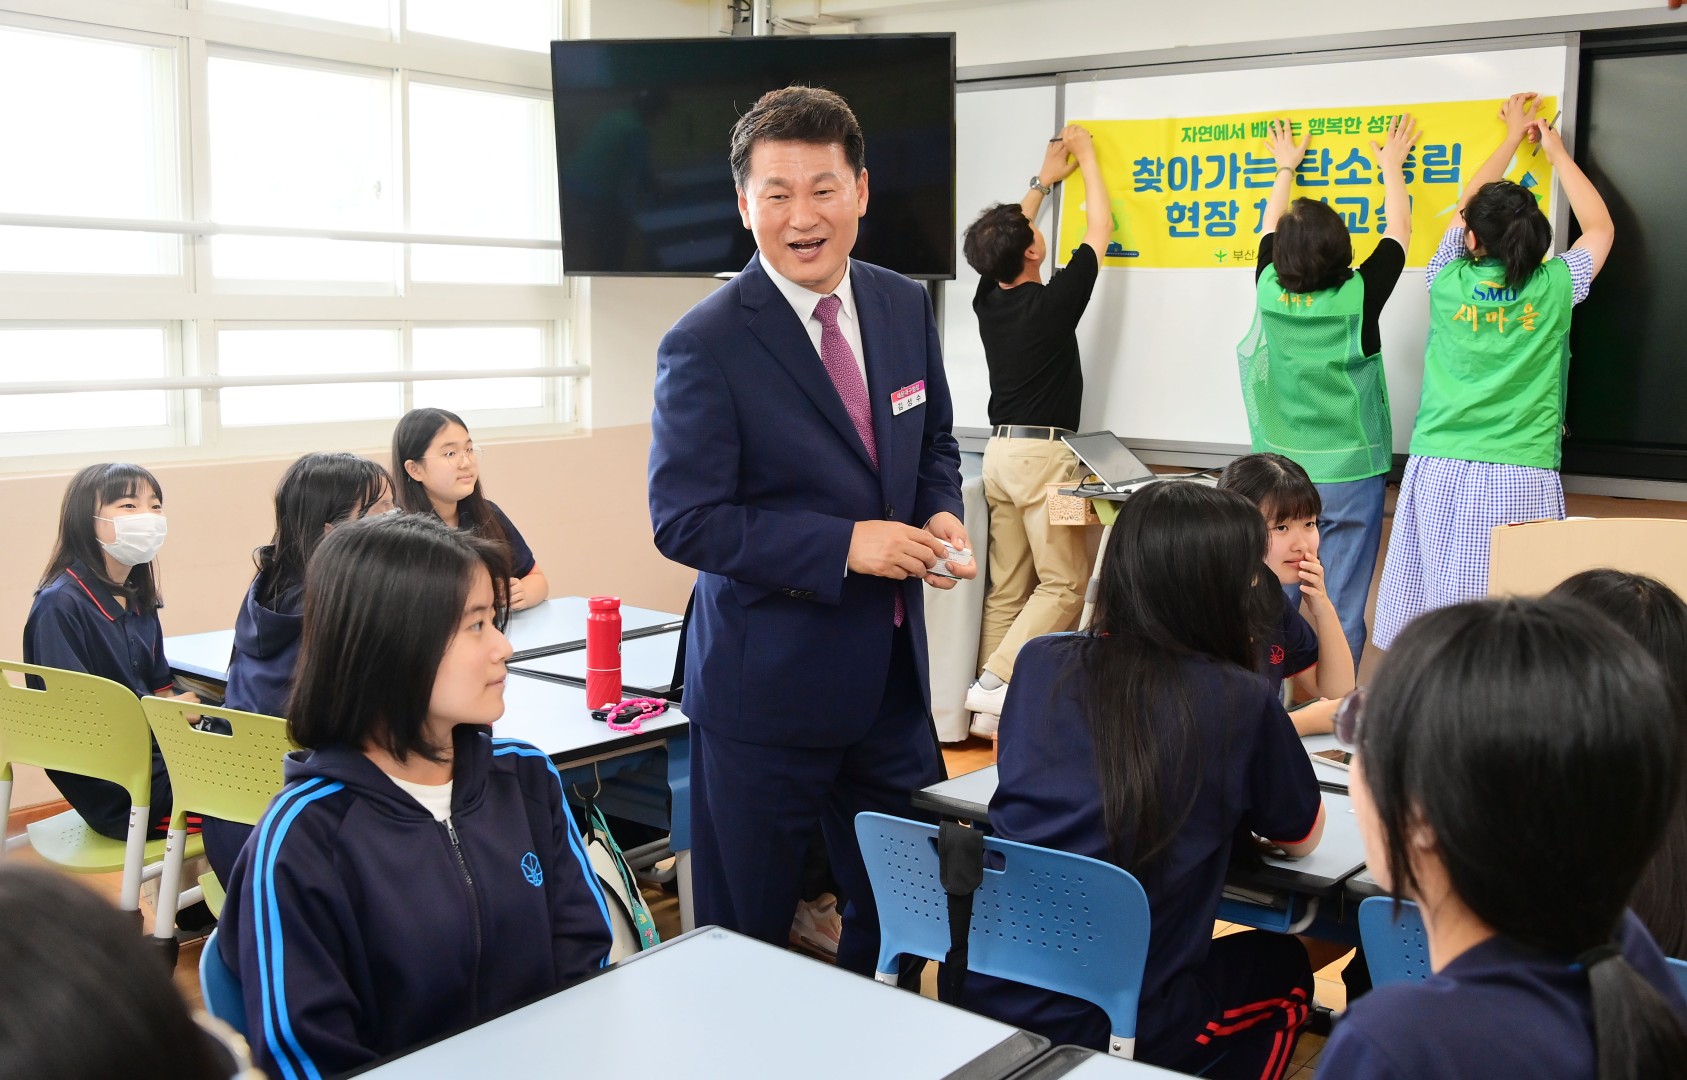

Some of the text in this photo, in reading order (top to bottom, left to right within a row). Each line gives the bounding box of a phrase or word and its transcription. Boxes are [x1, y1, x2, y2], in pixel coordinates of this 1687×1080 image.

[1181, 123, 1245, 142] 자연에서
[1308, 117, 1362, 135] 행복한
[1133, 152, 1277, 193] 찾아가는
[1166, 199, 1240, 238] 현장
[1472, 284, 1518, 301] SMU
[1452, 303, 1540, 333] 새마을
